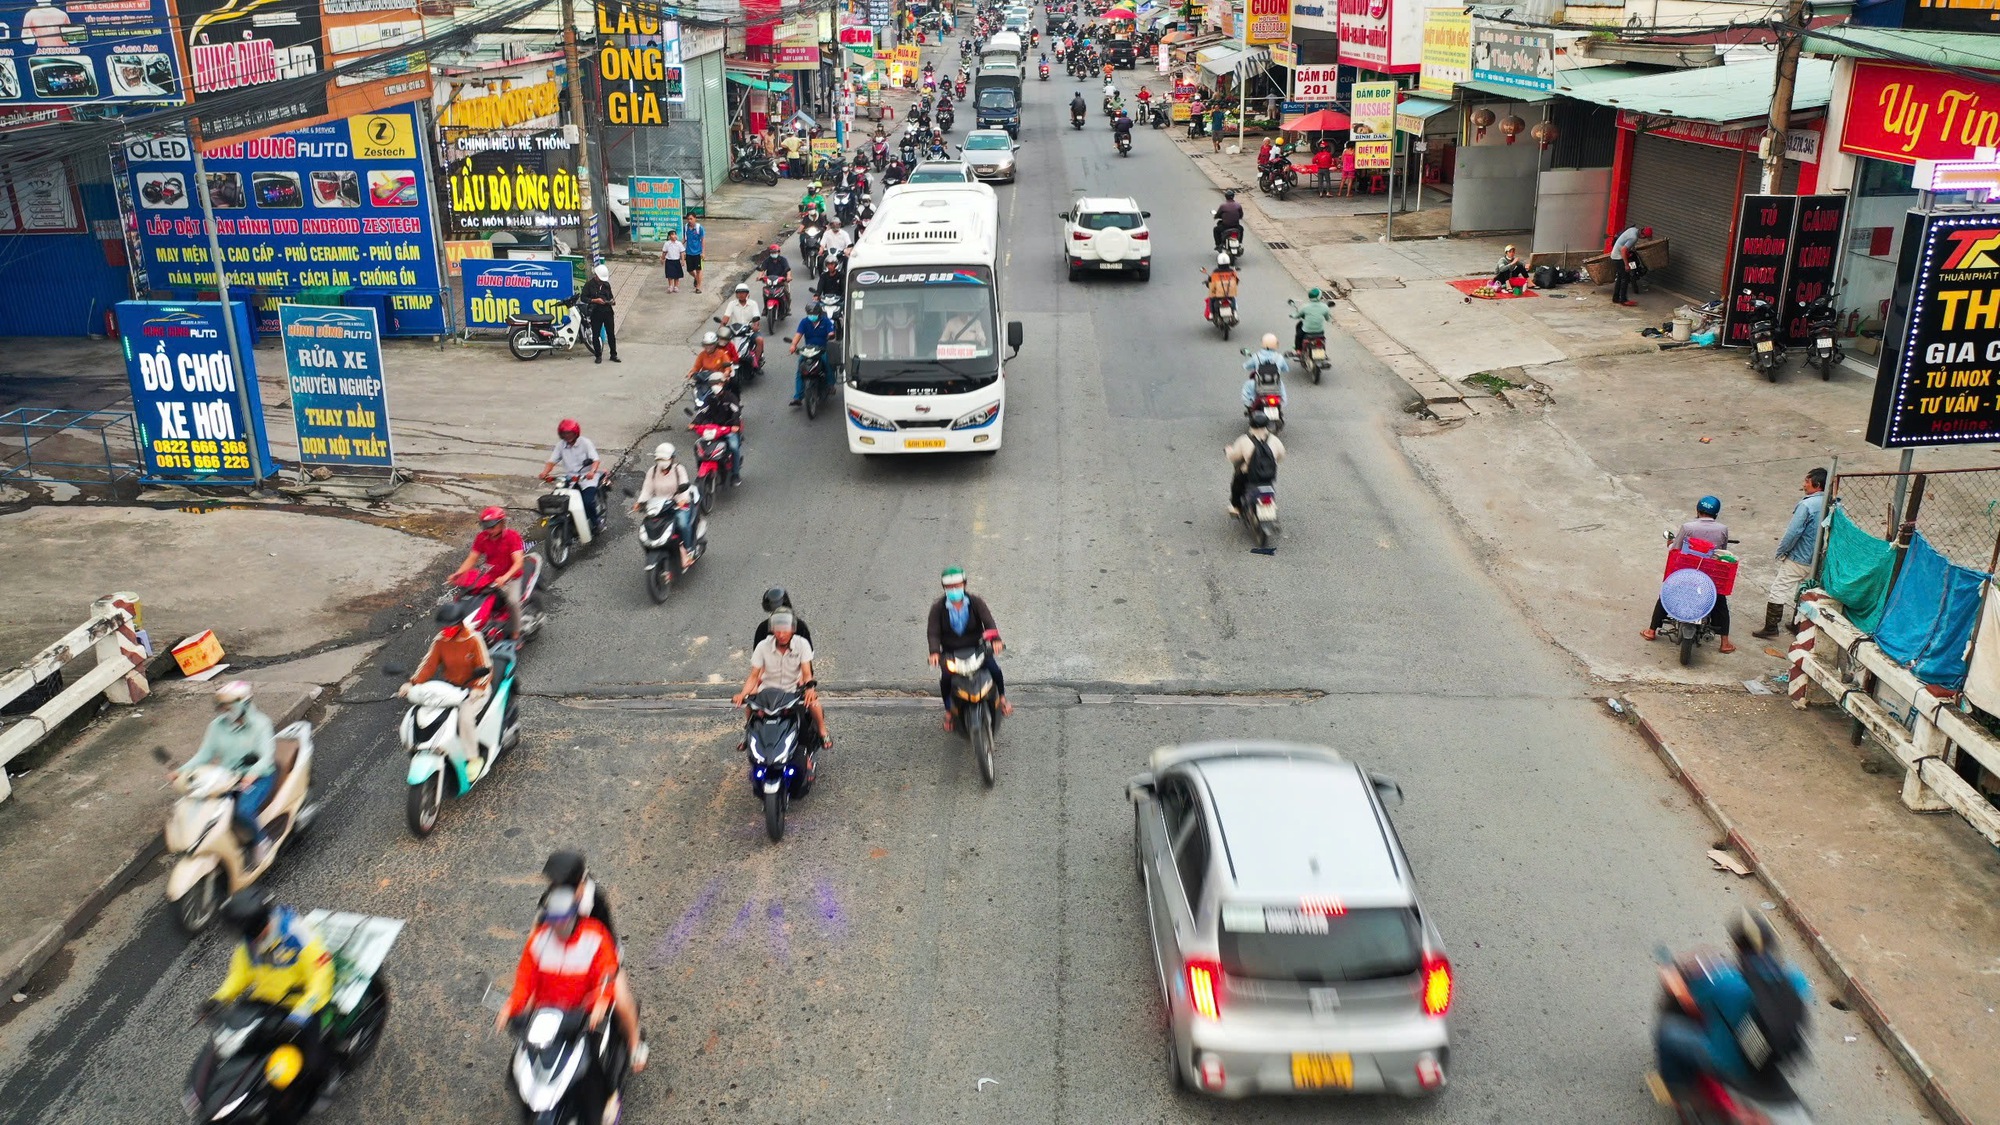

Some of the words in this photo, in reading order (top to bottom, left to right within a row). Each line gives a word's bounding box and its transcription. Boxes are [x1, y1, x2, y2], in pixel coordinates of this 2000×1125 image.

[276, 45, 317, 80] AUTO
[601, 40, 664, 80] ÔNG
[1304, 85, 1328, 94] 201
[608, 85, 662, 125] GIÀ
[1355, 102, 1391, 116] MASSAGE
[1879, 82, 1928, 152] Uy
[1691, 124, 1705, 136] CHO
[130, 140, 185, 158] OLED
[298, 142, 348, 157] AUTO
[364, 148, 405, 156] Zestech
[458, 135, 489, 150] CHÍNH
[492, 136, 515, 152] HIỆU
[518, 136, 532, 152] HỆ
[1358, 144, 1372, 157] DIỆT
[451, 157, 485, 212] LẨU
[488, 166, 512, 211] BÒ
[516, 164, 550, 211] ÔNG
[652, 179, 674, 193] THẤT
[656, 196, 679, 210] QUÂN
[461, 216, 480, 227] CÁC
[482, 214, 503, 227] MÓN
[561, 214, 580, 225] DÂN
[1761, 203, 1778, 226] TỦ
[1802, 206, 1839, 231] CÁNH
[146, 214, 172, 235] LẮP
[175, 216, 200, 238] ĐẶT
[203, 216, 236, 235] ÀN
[237, 216, 270, 235] HÌNH
[272, 219, 298, 234] DVD
[302, 218, 360, 234] ANDROID
[362, 217, 421, 233] ZESTECH
[156, 247, 179, 262] MAY
[182, 244, 208, 265] MỆN
[228, 247, 250, 262] CAO
[252, 242, 274, 262] CẤP
[285, 242, 307, 261] PHỦ
[310, 246, 359, 261] CERAMIC
[369, 241, 392, 261] PHỦ
[1743, 235, 1786, 256] NHÔM
[1798, 242, 1831, 268] KÍNH
[258, 269, 288, 289] NHIỆT
[300, 269, 329, 286] CÁCH
[332, 269, 350, 286] ÂM
[360, 266, 398, 286] CHỐNG
[477, 273, 503, 287] HÙNG
[504, 273, 531, 288] DŨNG
[531, 279, 558, 288] AUTO
[878, 273, 925, 284] ALLERGO
[1743, 267, 1777, 284] INOX
[391, 295, 433, 310] IETMAP
[1796, 282, 1822, 303] CAO
[190, 329, 218, 338] AUTO
[344, 330, 371, 339] AUTO
[298, 344, 338, 369] RỬA
[343, 351, 368, 370] XE
[1925, 342, 1975, 364] GIA
[139, 340, 174, 392] ĐỒ
[178, 351, 236, 392] CHƠI
[292, 374, 337, 395] CHUYÊN
[340, 375, 381, 400] NGHIỆP
[1926, 366, 1946, 388] TỦ
[1951, 369, 1992, 388] INOX
[1920, 395, 1942, 414] TƯ
[1945, 390, 1979, 413] VẤN
[157, 402, 190, 440] XE
[192, 398, 236, 439] HƠI
[305, 408, 343, 427] THAY
[347, 402, 375, 428] DẦU
[1930, 419, 1994, 432] Hotline:
[154, 440, 188, 454] 0822
[191, 440, 218, 454] 666
[221, 441, 247, 454] 368
[301, 437, 326, 459] DỌN
[329, 435, 351, 460] NỘI
[354, 432, 387, 457] THẤT
[156, 455, 191, 468] 0815
[194, 455, 220, 468] 666
[224, 456, 250, 469] 226
